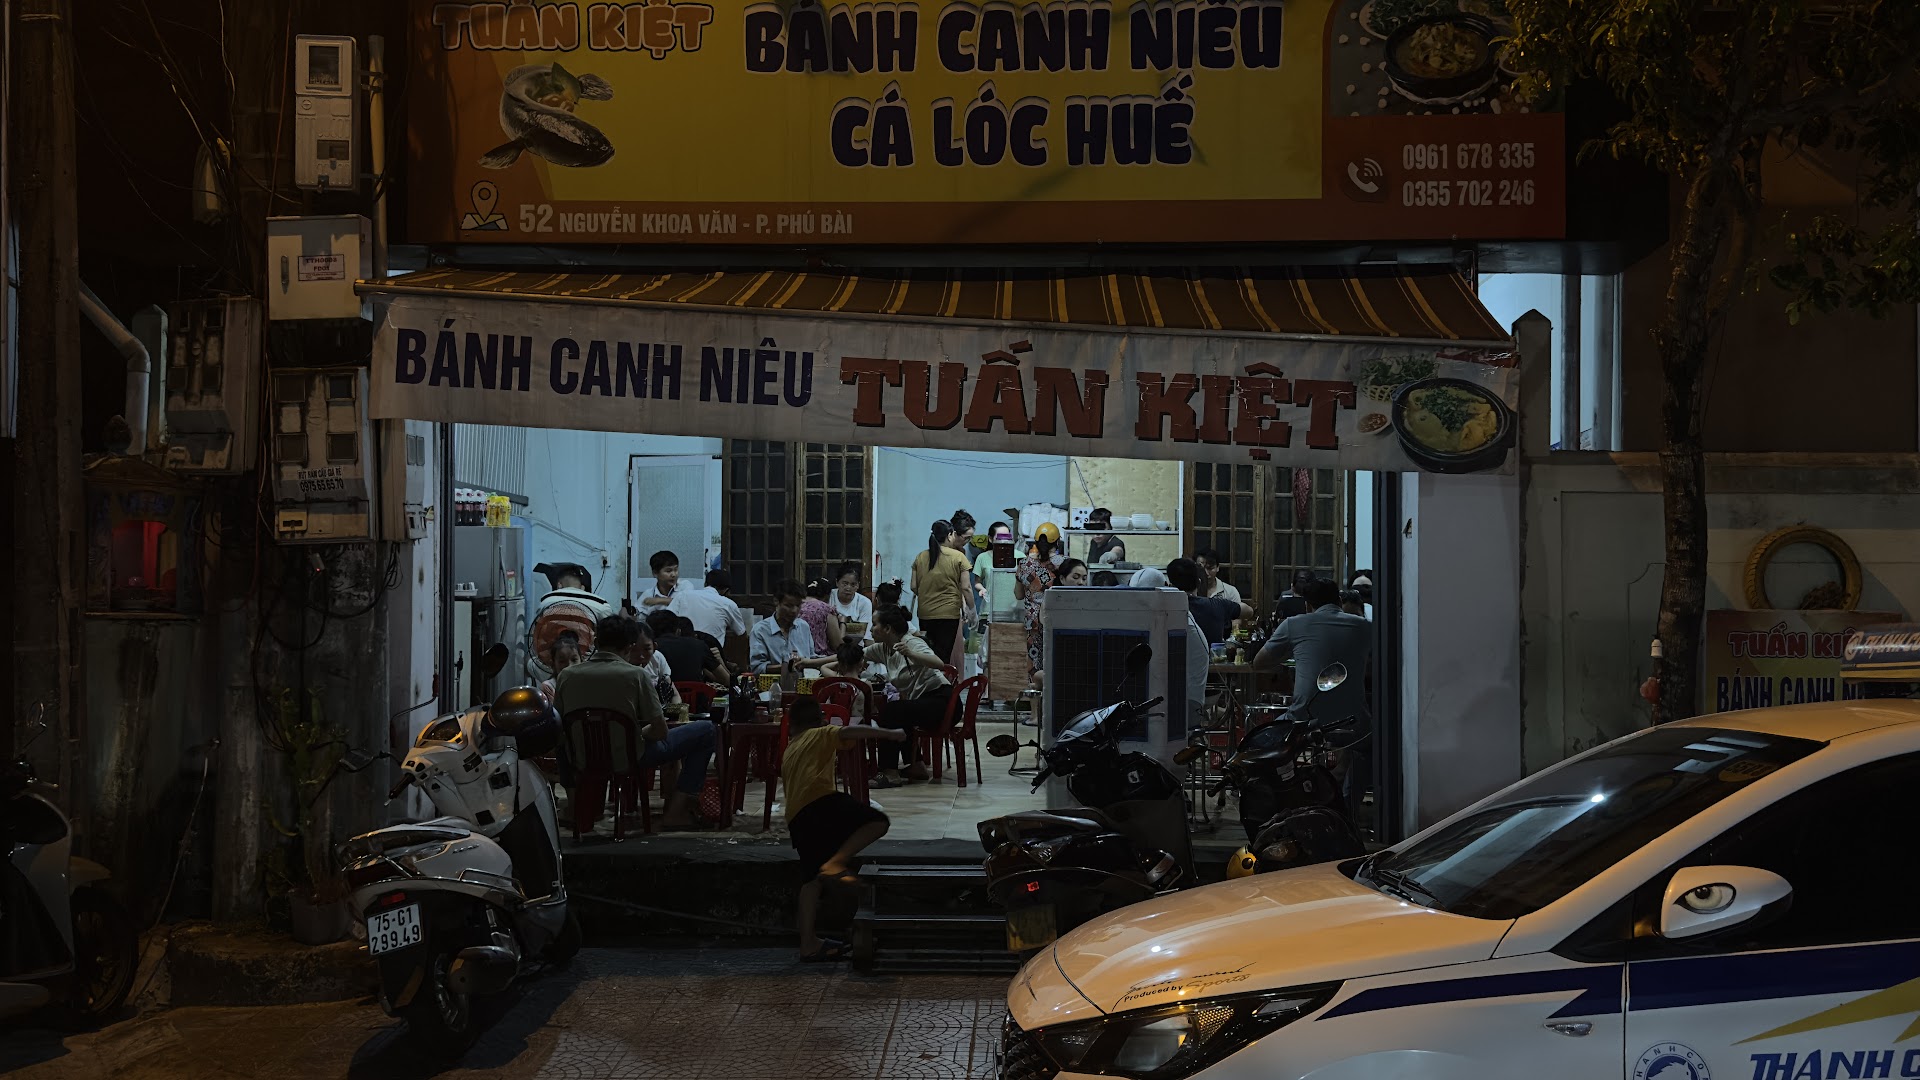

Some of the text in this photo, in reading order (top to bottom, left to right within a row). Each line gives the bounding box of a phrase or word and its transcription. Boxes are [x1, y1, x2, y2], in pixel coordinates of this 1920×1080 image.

[937, 3, 1110, 73] CANH
[831, 71, 1194, 167] CÁ LÓC HUẾ
[1402, 142, 1535, 170] 0961 678 335
[1402, 179, 1535, 207] 0355 702 246
[519, 204, 553, 233] 52
[559, 206, 636, 233] NGUYỄN
[642, 213, 693, 234] KHOA
[699, 210, 737, 234] VĂN
[756, 213, 771, 234] P.
[776, 209, 815, 234] PHÚ
[820, 210, 853, 234] BÀI
[394, 318, 1357, 461] BÁNH CANH NIÊU TUẤN KIỆT
[1728, 622, 1808, 658] TUẤN
[1717, 667, 1773, 713] BÁNH
[1780, 676, 1835, 706] CANH
[374, 906, 412, 933] 75-G1
[371, 924, 420, 954] 299.49
[1124, 986, 1170, 1002] Produced
